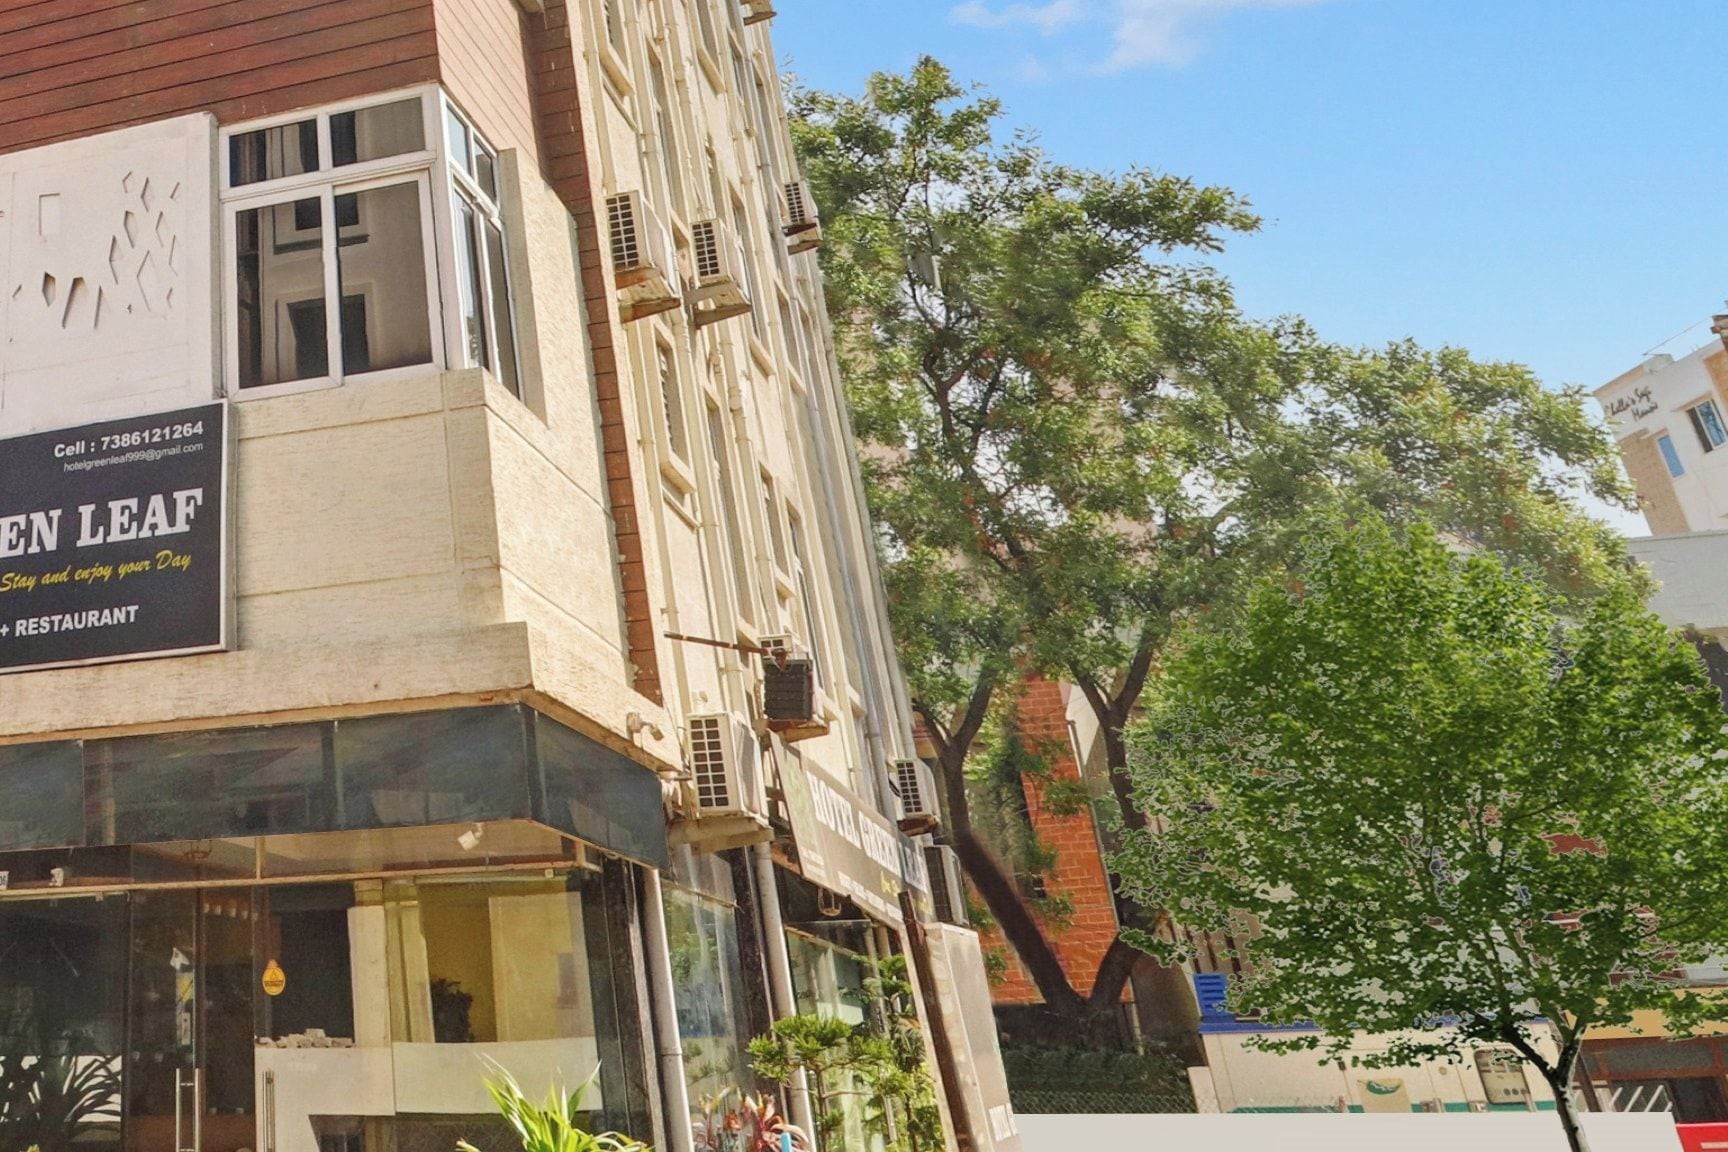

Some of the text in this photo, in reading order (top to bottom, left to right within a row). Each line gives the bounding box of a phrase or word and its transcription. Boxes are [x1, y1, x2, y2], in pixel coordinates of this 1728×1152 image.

[54, 440, 85, 458] Cell
[100, 420, 204, 451] 7386121264
[63, 442, 204, 473] hotelgreenleaf999@gmail.com
[76, 487, 203, 547] LEAF
[41, 565, 71, 584] and
[74, 562, 113, 584] enjoy
[118, 559, 152, 578] your
[156, 549, 192, 572] Day
[15, 605, 139, 638] RESTAURANT
[805, 770, 863, 850] HOTEL
[858, 810, 903, 878] GREEN
